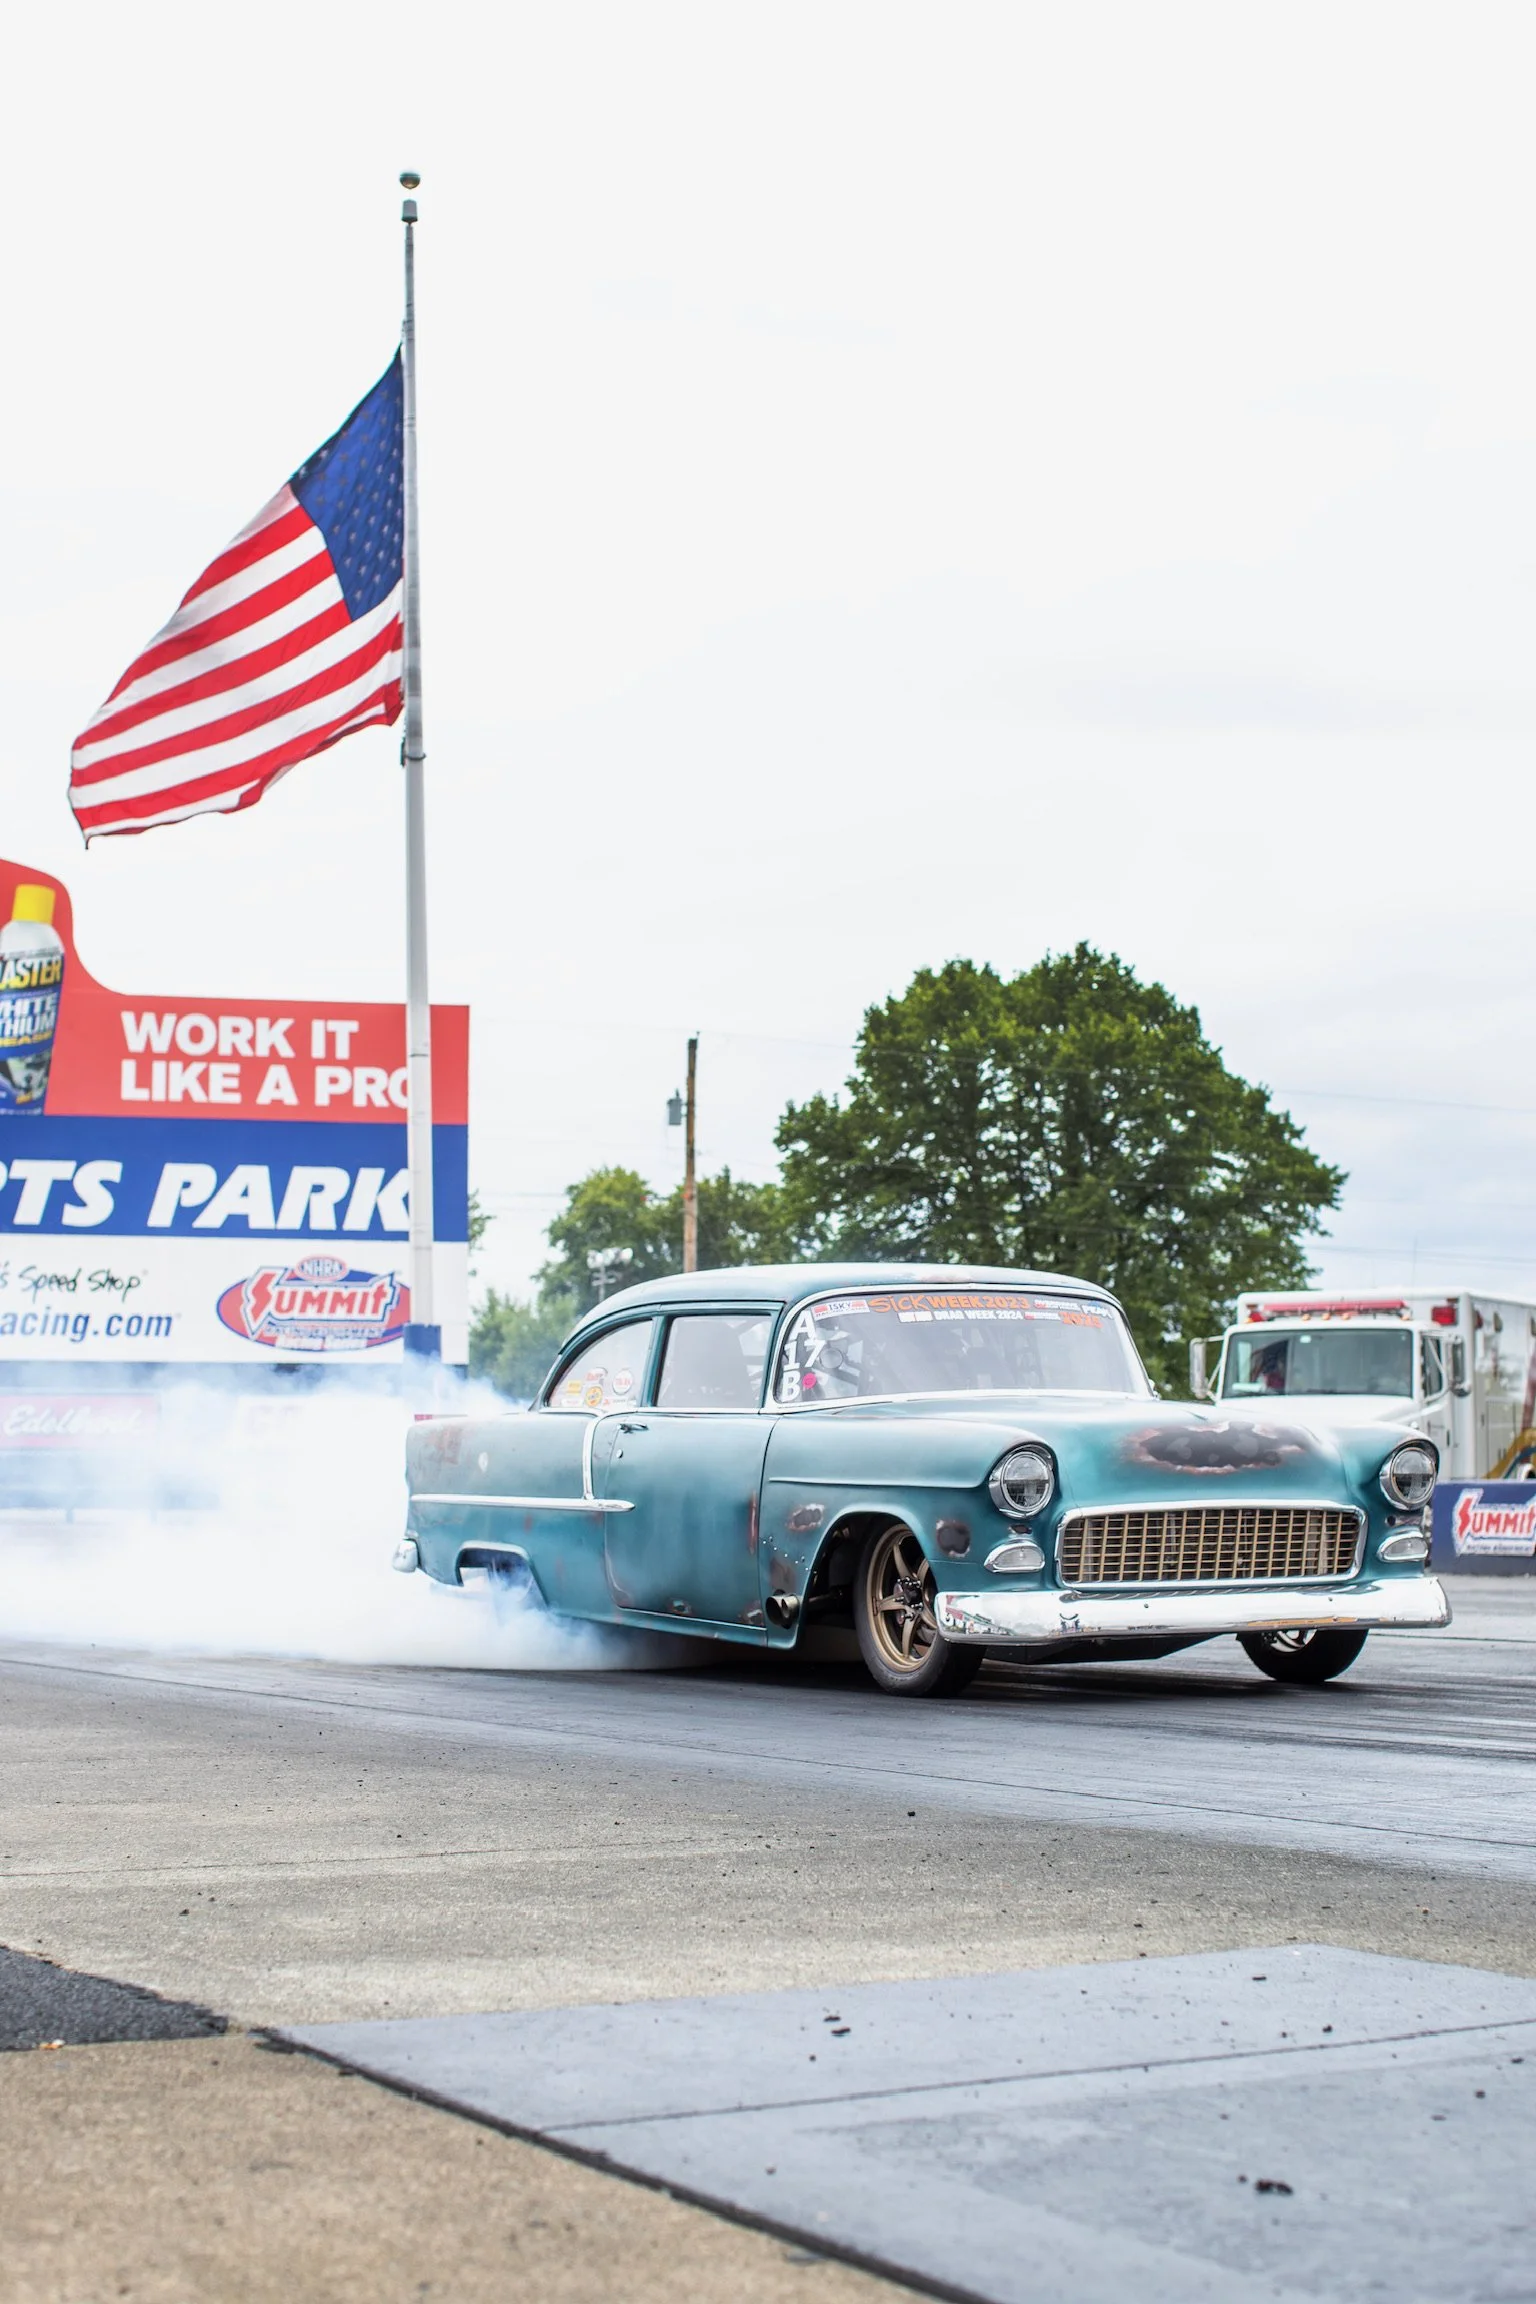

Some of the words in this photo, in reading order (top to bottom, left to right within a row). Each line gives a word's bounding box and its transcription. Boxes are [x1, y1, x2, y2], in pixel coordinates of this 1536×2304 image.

[121, 1011, 295, 1058] WORK
[311, 1020, 360, 1060] IT
[120, 1059, 241, 1103] LIKE
[256, 1065, 299, 1106] A
[0, 1159, 123, 1228] TS
[147, 1163, 411, 1232] PARK
[301, 1256, 344, 1278] NHRA
[18, 1266, 83, 1304] Speed
[87, 1268, 141, 1304] Shop
[249, 1273, 389, 1326] SUMMIT
[925, 1295, 981, 1309] WEEK
[983, 1295, 1030, 1310] 2023
[964, 1310, 997, 1321] WEEK
[0, 1306, 173, 1343] acing.com
[788, 1310, 819, 1341] A
[784, 1340, 826, 1371] 17
[781, 1371, 801, 1402] B
[2, 1404, 143, 1436] Edelbk
[1458, 1497, 1536, 1537] SUMMIT
